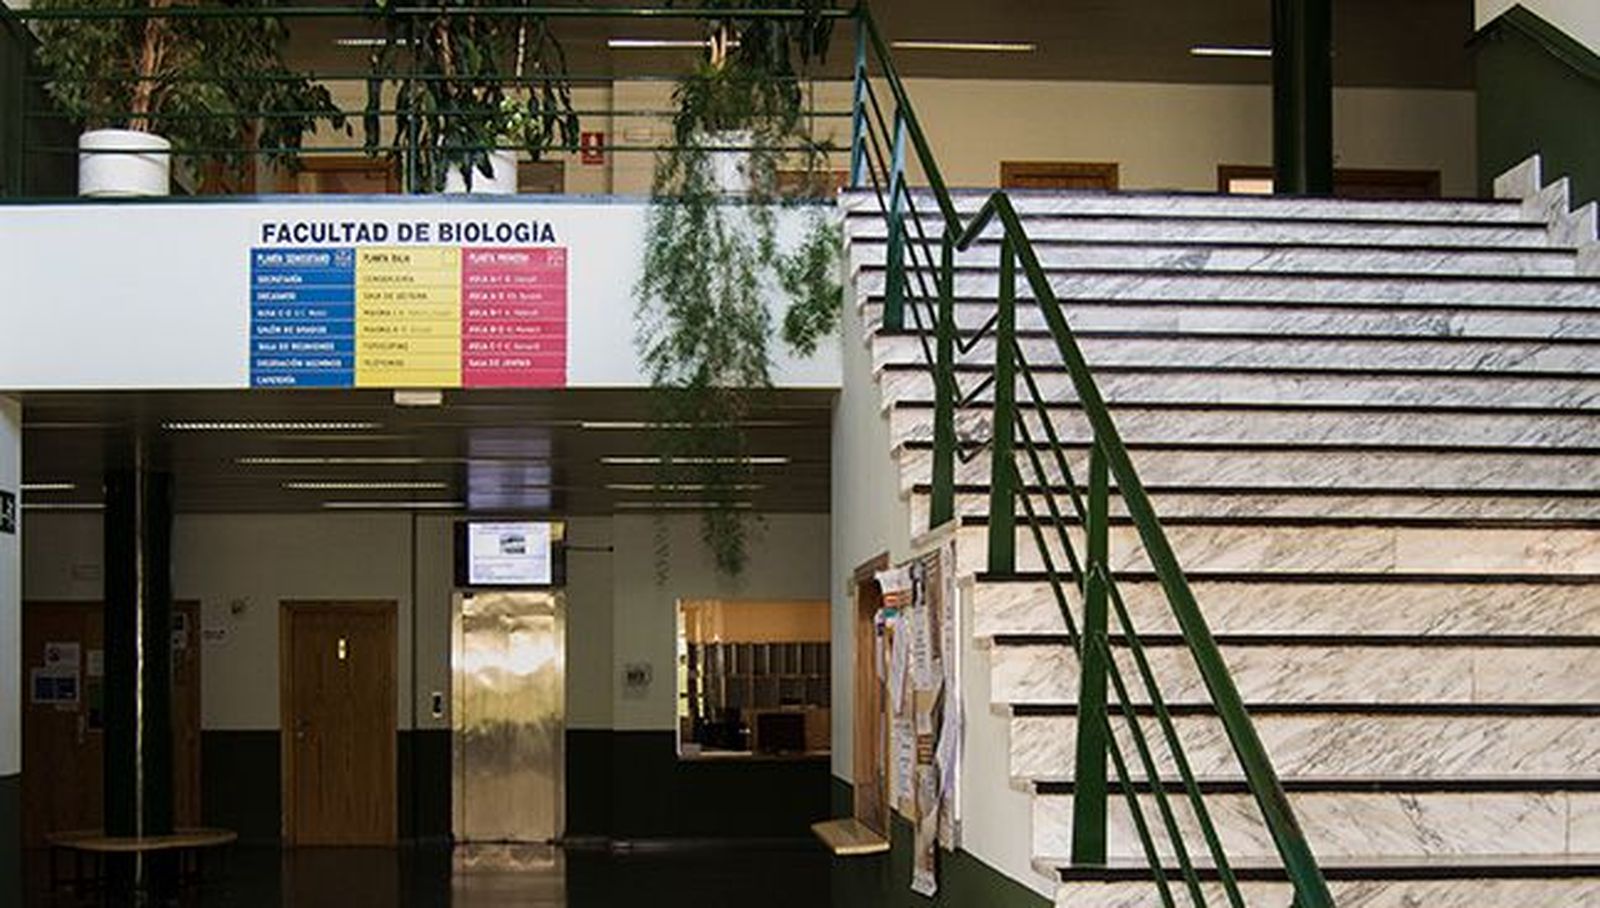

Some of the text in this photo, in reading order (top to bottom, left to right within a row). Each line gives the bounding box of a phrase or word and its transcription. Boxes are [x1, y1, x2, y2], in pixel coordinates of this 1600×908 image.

[262, 220, 556, 242] FACULTAD DE BIOLOGÍA
